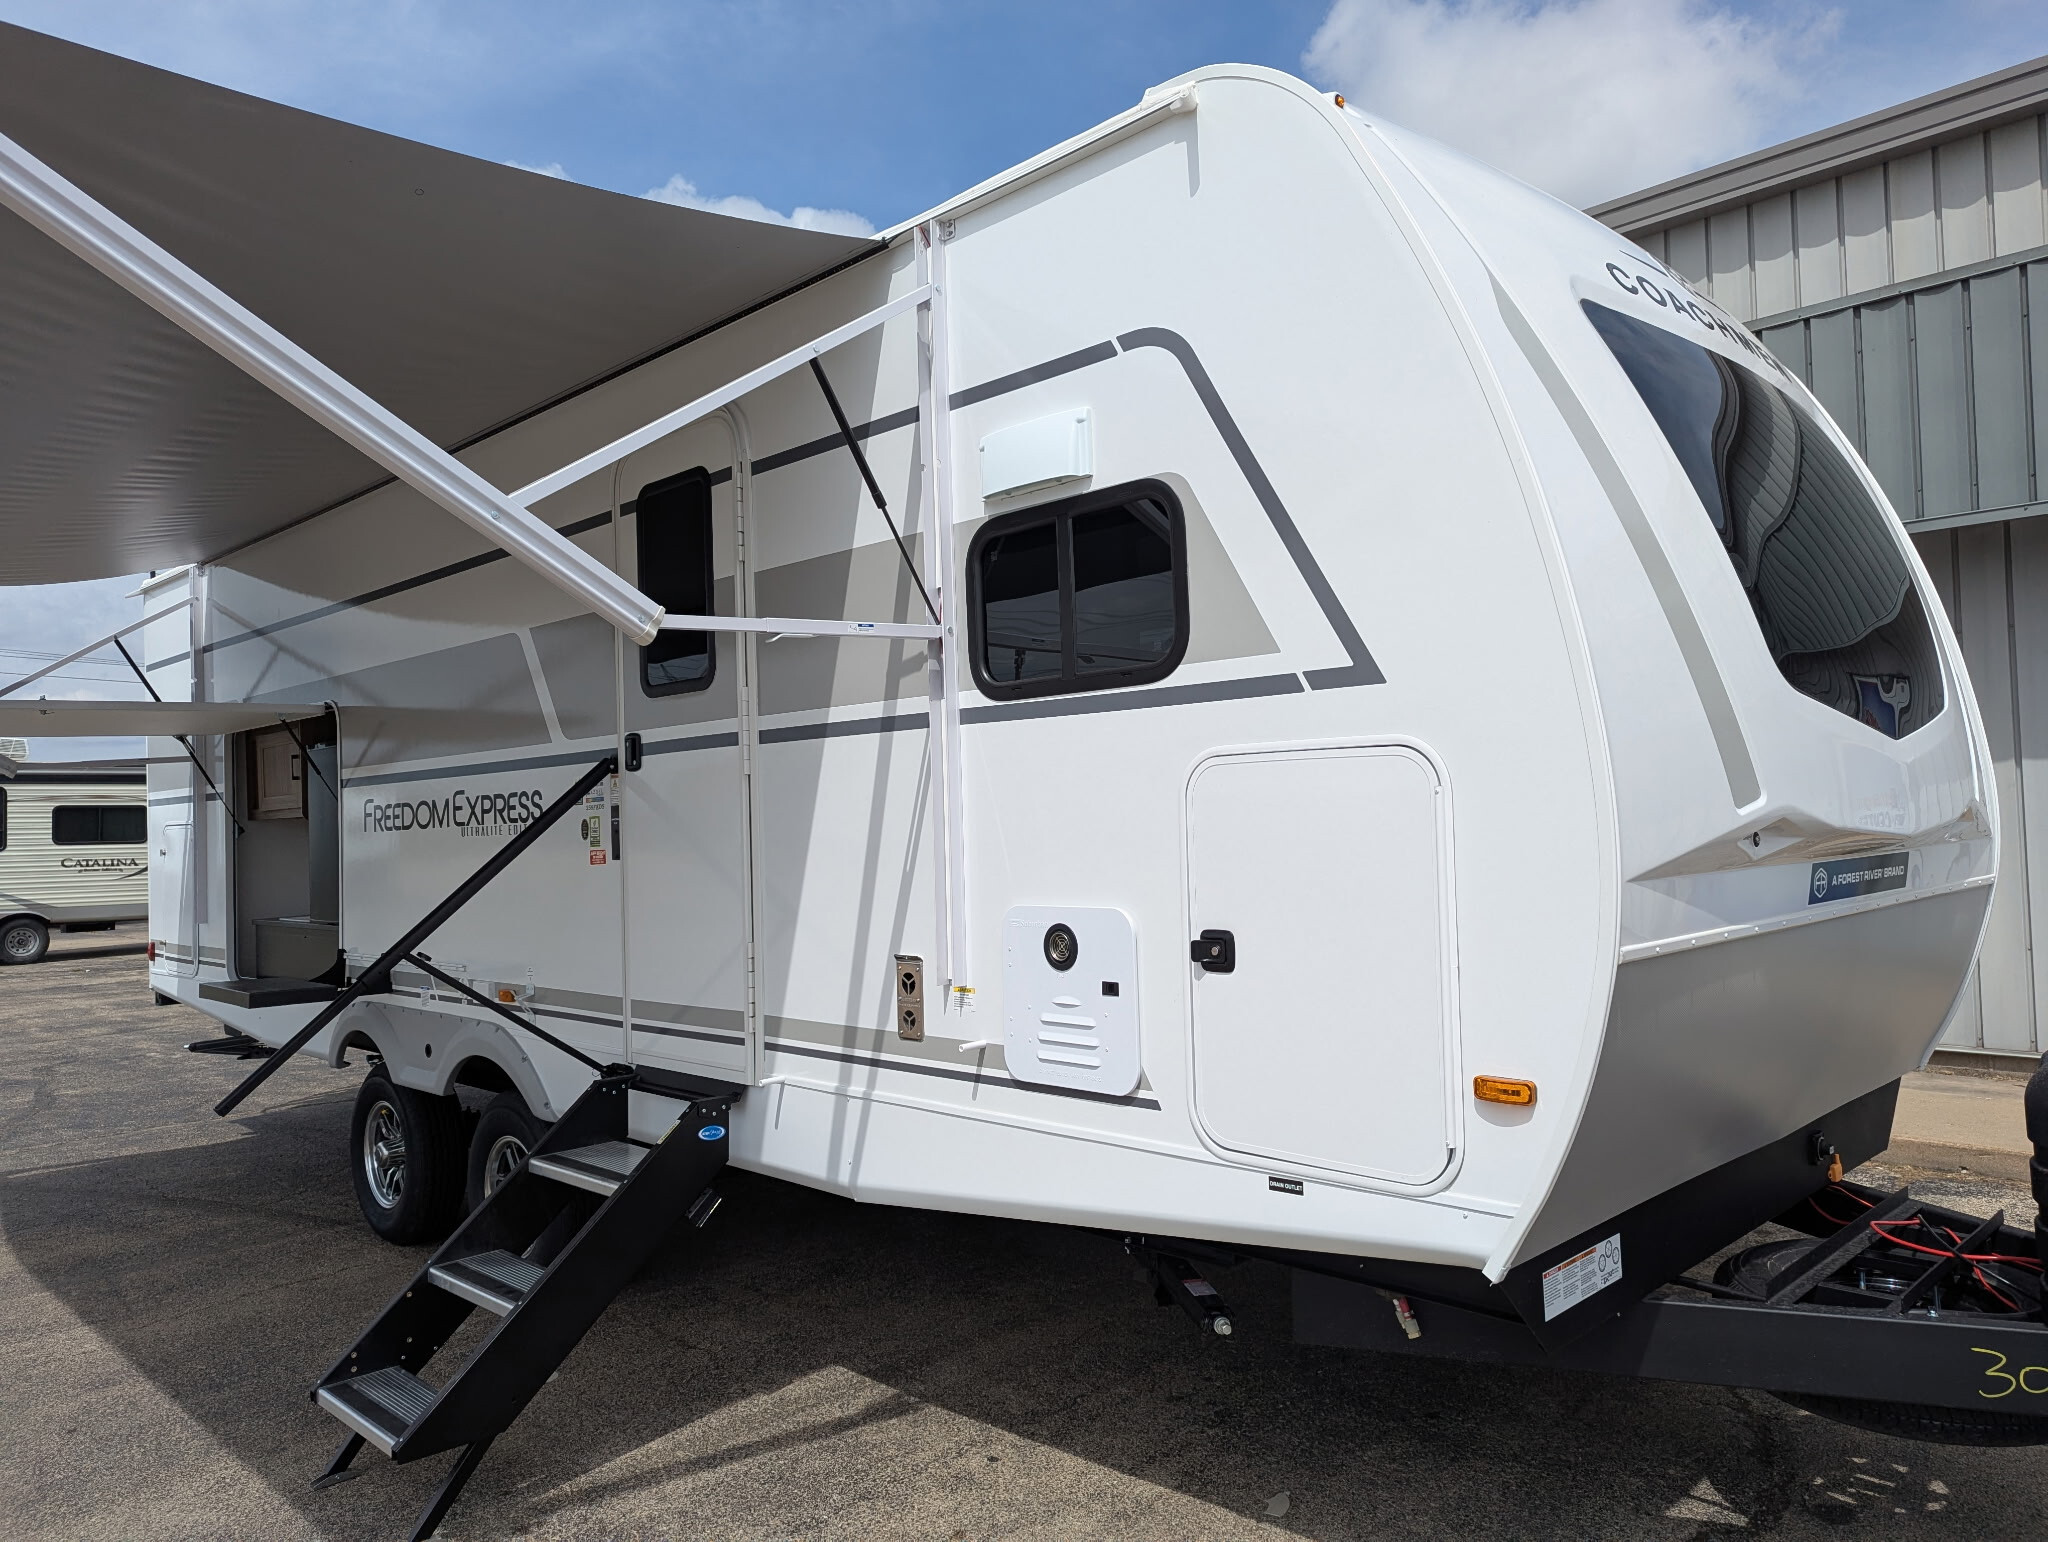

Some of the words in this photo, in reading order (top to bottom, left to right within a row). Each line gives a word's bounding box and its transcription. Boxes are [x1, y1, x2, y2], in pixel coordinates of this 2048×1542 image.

[1605, 262, 1793, 383] COACHMEN
[363, 798, 450, 833] FREEDOM
[452, 789, 544, 827] EXPRESS
[460, 826, 503, 838] ULTRALITE
[508, 823, 528, 836] EDIT
[61, 858, 139, 868] CATALINA
[1831, 877, 1837, 886] A
[1838, 872, 1863, 885] FOREST
[1864, 869, 1881, 880] RIVER
[1883, 865, 1904, 878] BRAND
[1270, 1180, 1284, 1188] DRAIN
[1284, 1183, 1303, 1191] OUTLET
